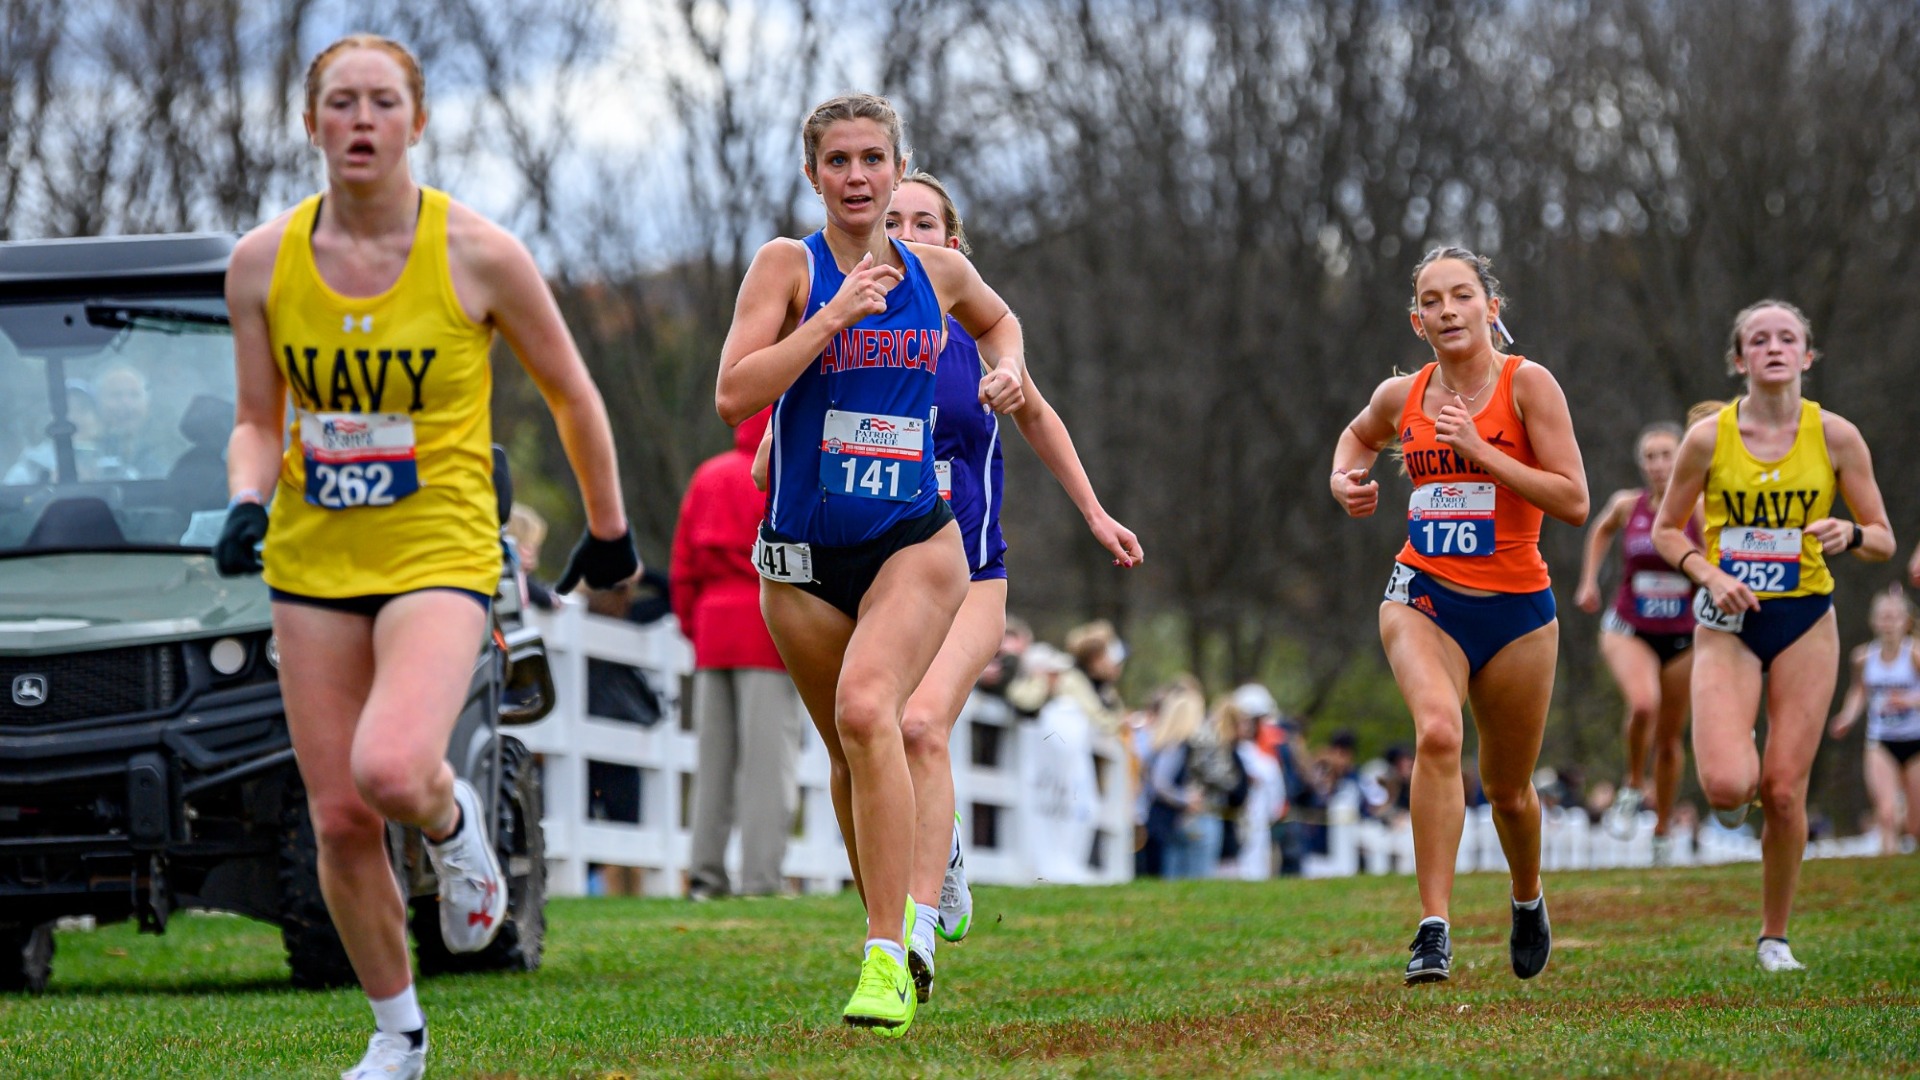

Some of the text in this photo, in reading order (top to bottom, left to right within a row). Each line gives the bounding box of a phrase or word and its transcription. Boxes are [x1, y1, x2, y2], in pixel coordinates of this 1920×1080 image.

[820, 329, 940, 375] AMERICAN
[285, 345, 437, 412] NAVY
[854, 437, 898, 446] LEAGUE
[855, 429, 899, 441] PATRIOT
[315, 463, 396, 507] 262
[841, 457, 900, 497] 141
[1722, 489, 1819, 529] NAVY
[1422, 521, 1478, 553] 176
[757, 539, 791, 577] 141
[1732, 561, 1785, 592] 252
[1642, 598, 1682, 618] 210
